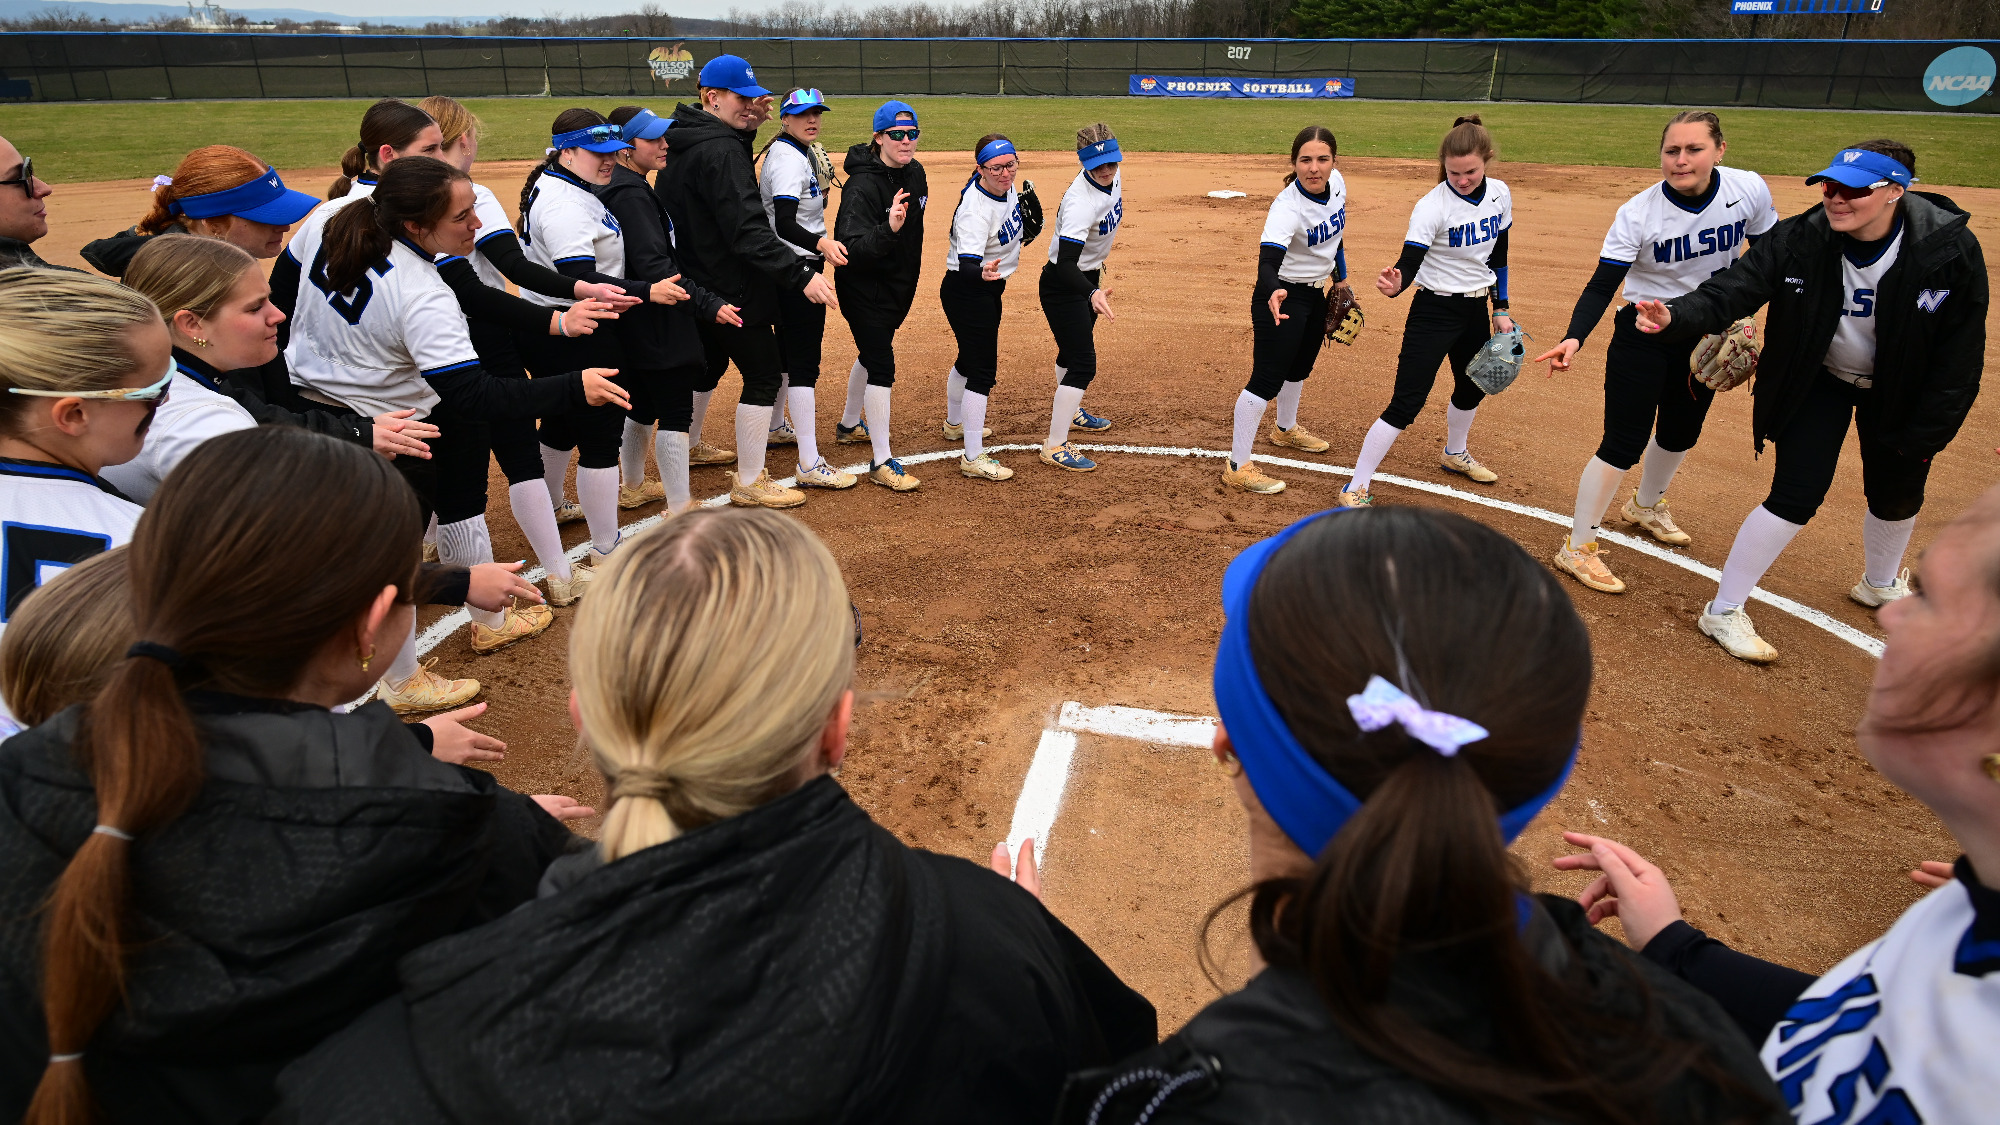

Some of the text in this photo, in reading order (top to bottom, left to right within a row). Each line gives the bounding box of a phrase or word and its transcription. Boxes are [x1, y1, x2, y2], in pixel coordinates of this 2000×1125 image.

[1734, 1, 1774, 11] PHOENIX
[1227, 46, 1251, 60] 207
[647, 60, 695, 70] WILSON
[655, 68, 689, 77] COLLEGE
[1167, 81, 1232, 92] PHOENIX
[1243, 83, 1314, 94] SOFTBALL
[1928, 75, 1992, 91] NCAA
[1094, 143, 1105, 152] W
[1843, 151, 1863, 163] W
[268, 176, 279, 189] W
[1306, 203, 1346, 247] WILSO
